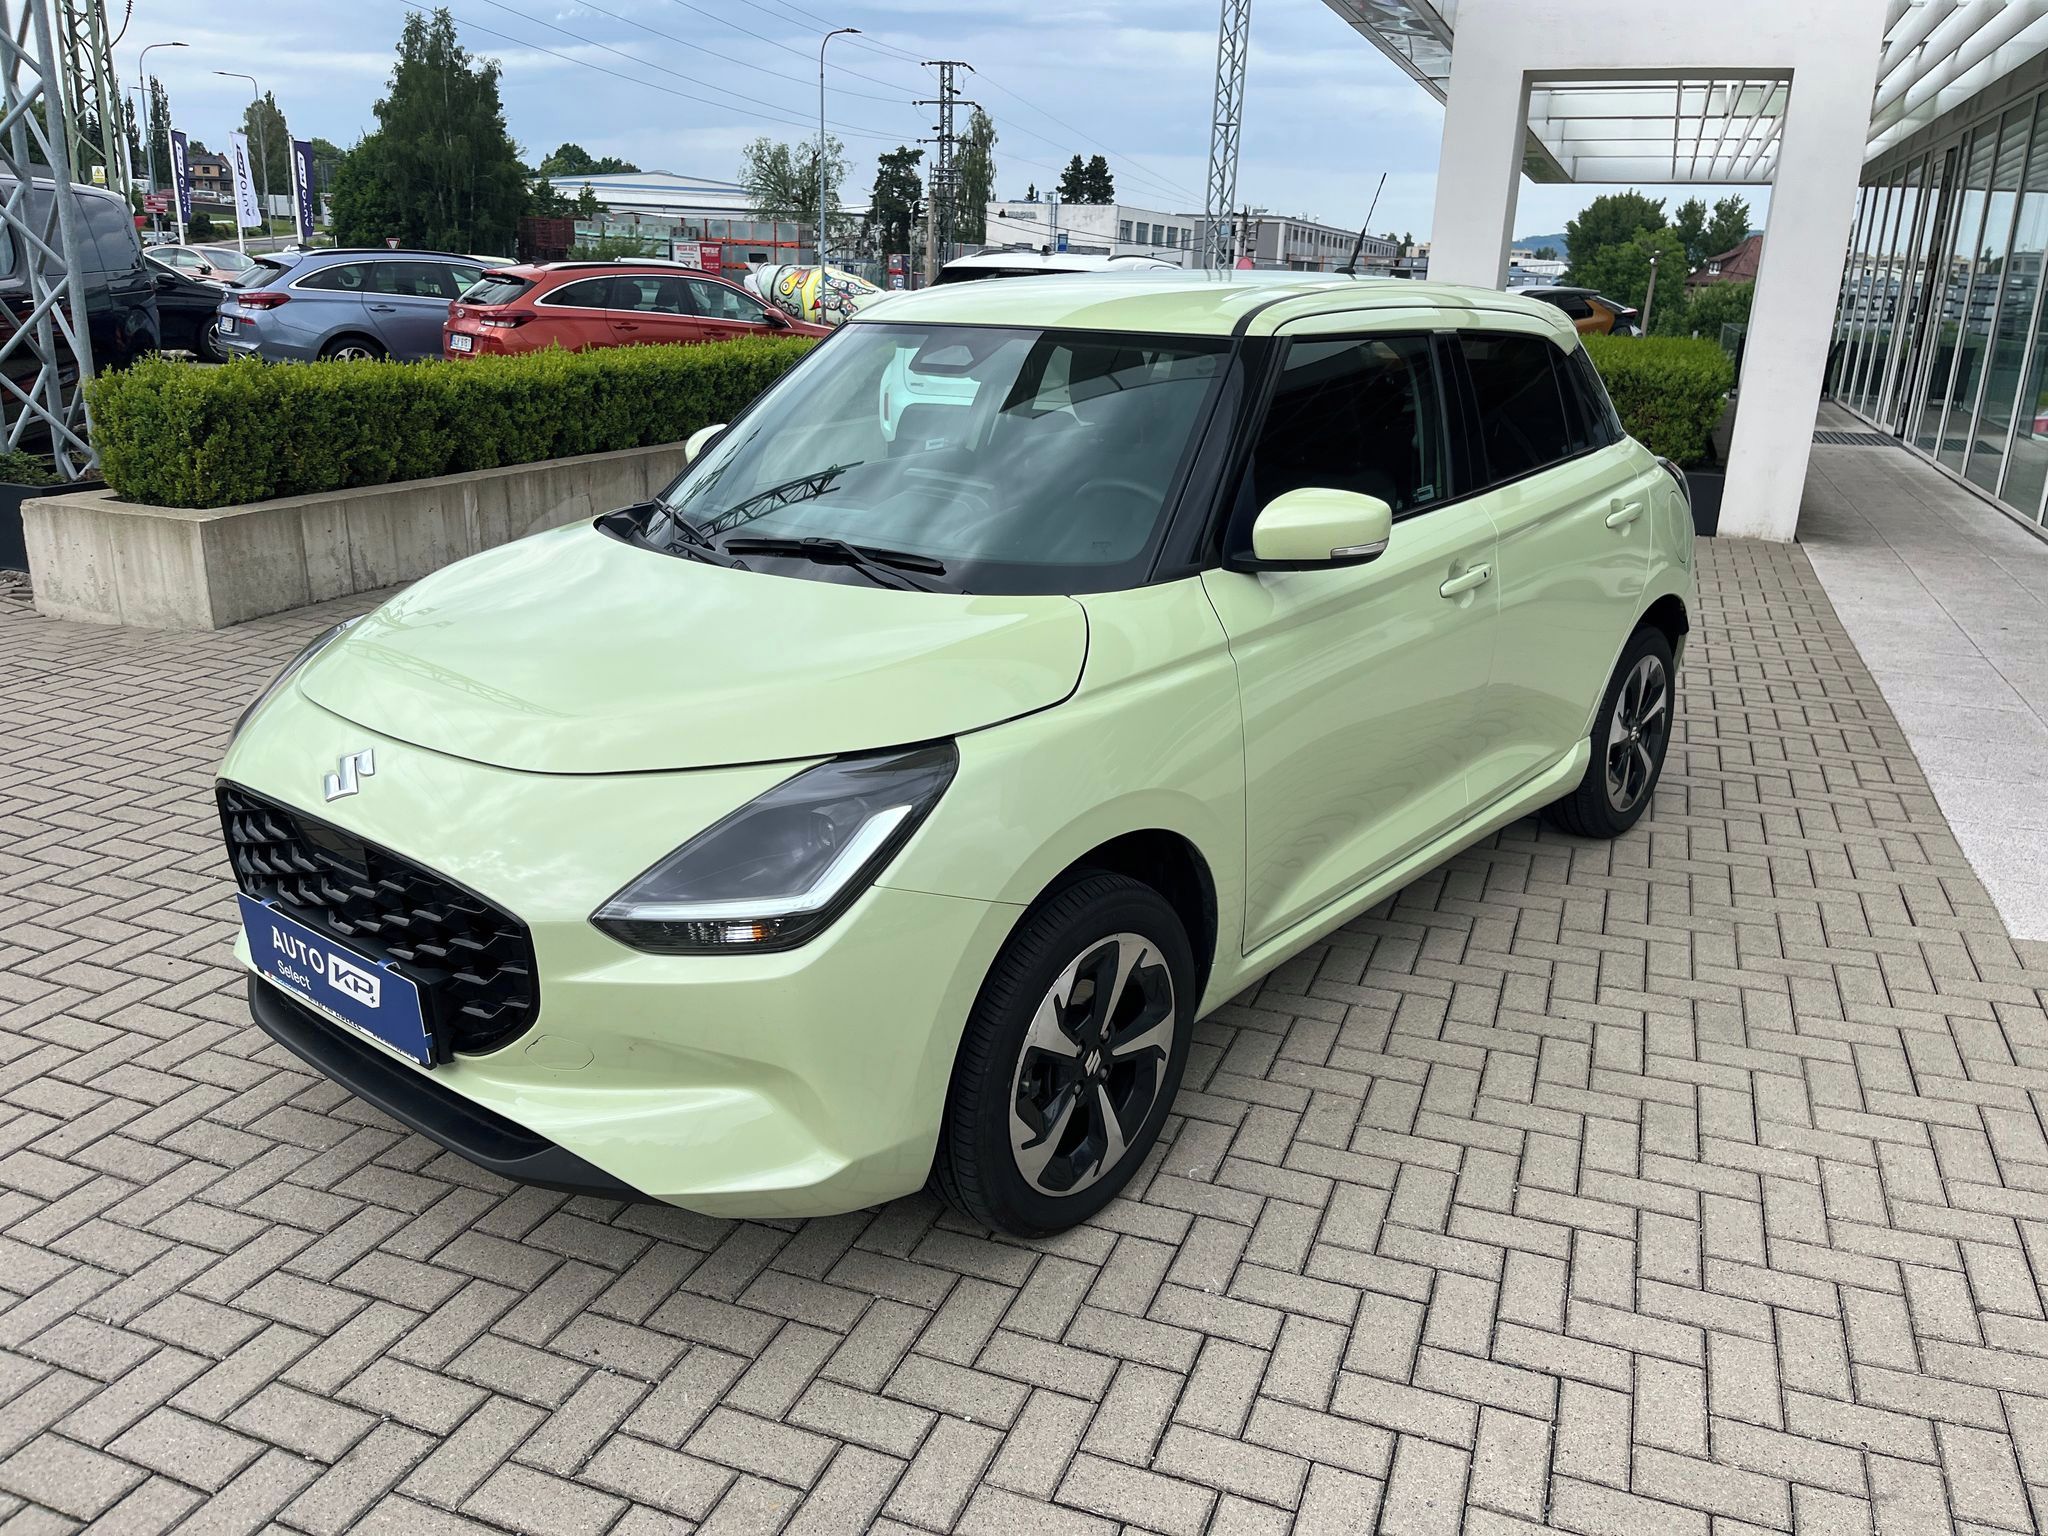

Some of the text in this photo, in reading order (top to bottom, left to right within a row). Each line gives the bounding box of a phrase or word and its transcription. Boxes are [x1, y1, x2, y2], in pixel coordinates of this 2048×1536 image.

[179, 178, 188, 212] AUTO
[240, 180, 251, 217] AUTO
[302, 189, 310, 227] AUTO
[271, 924, 326, 976] AUTO
[276, 958, 313, 992] Select
